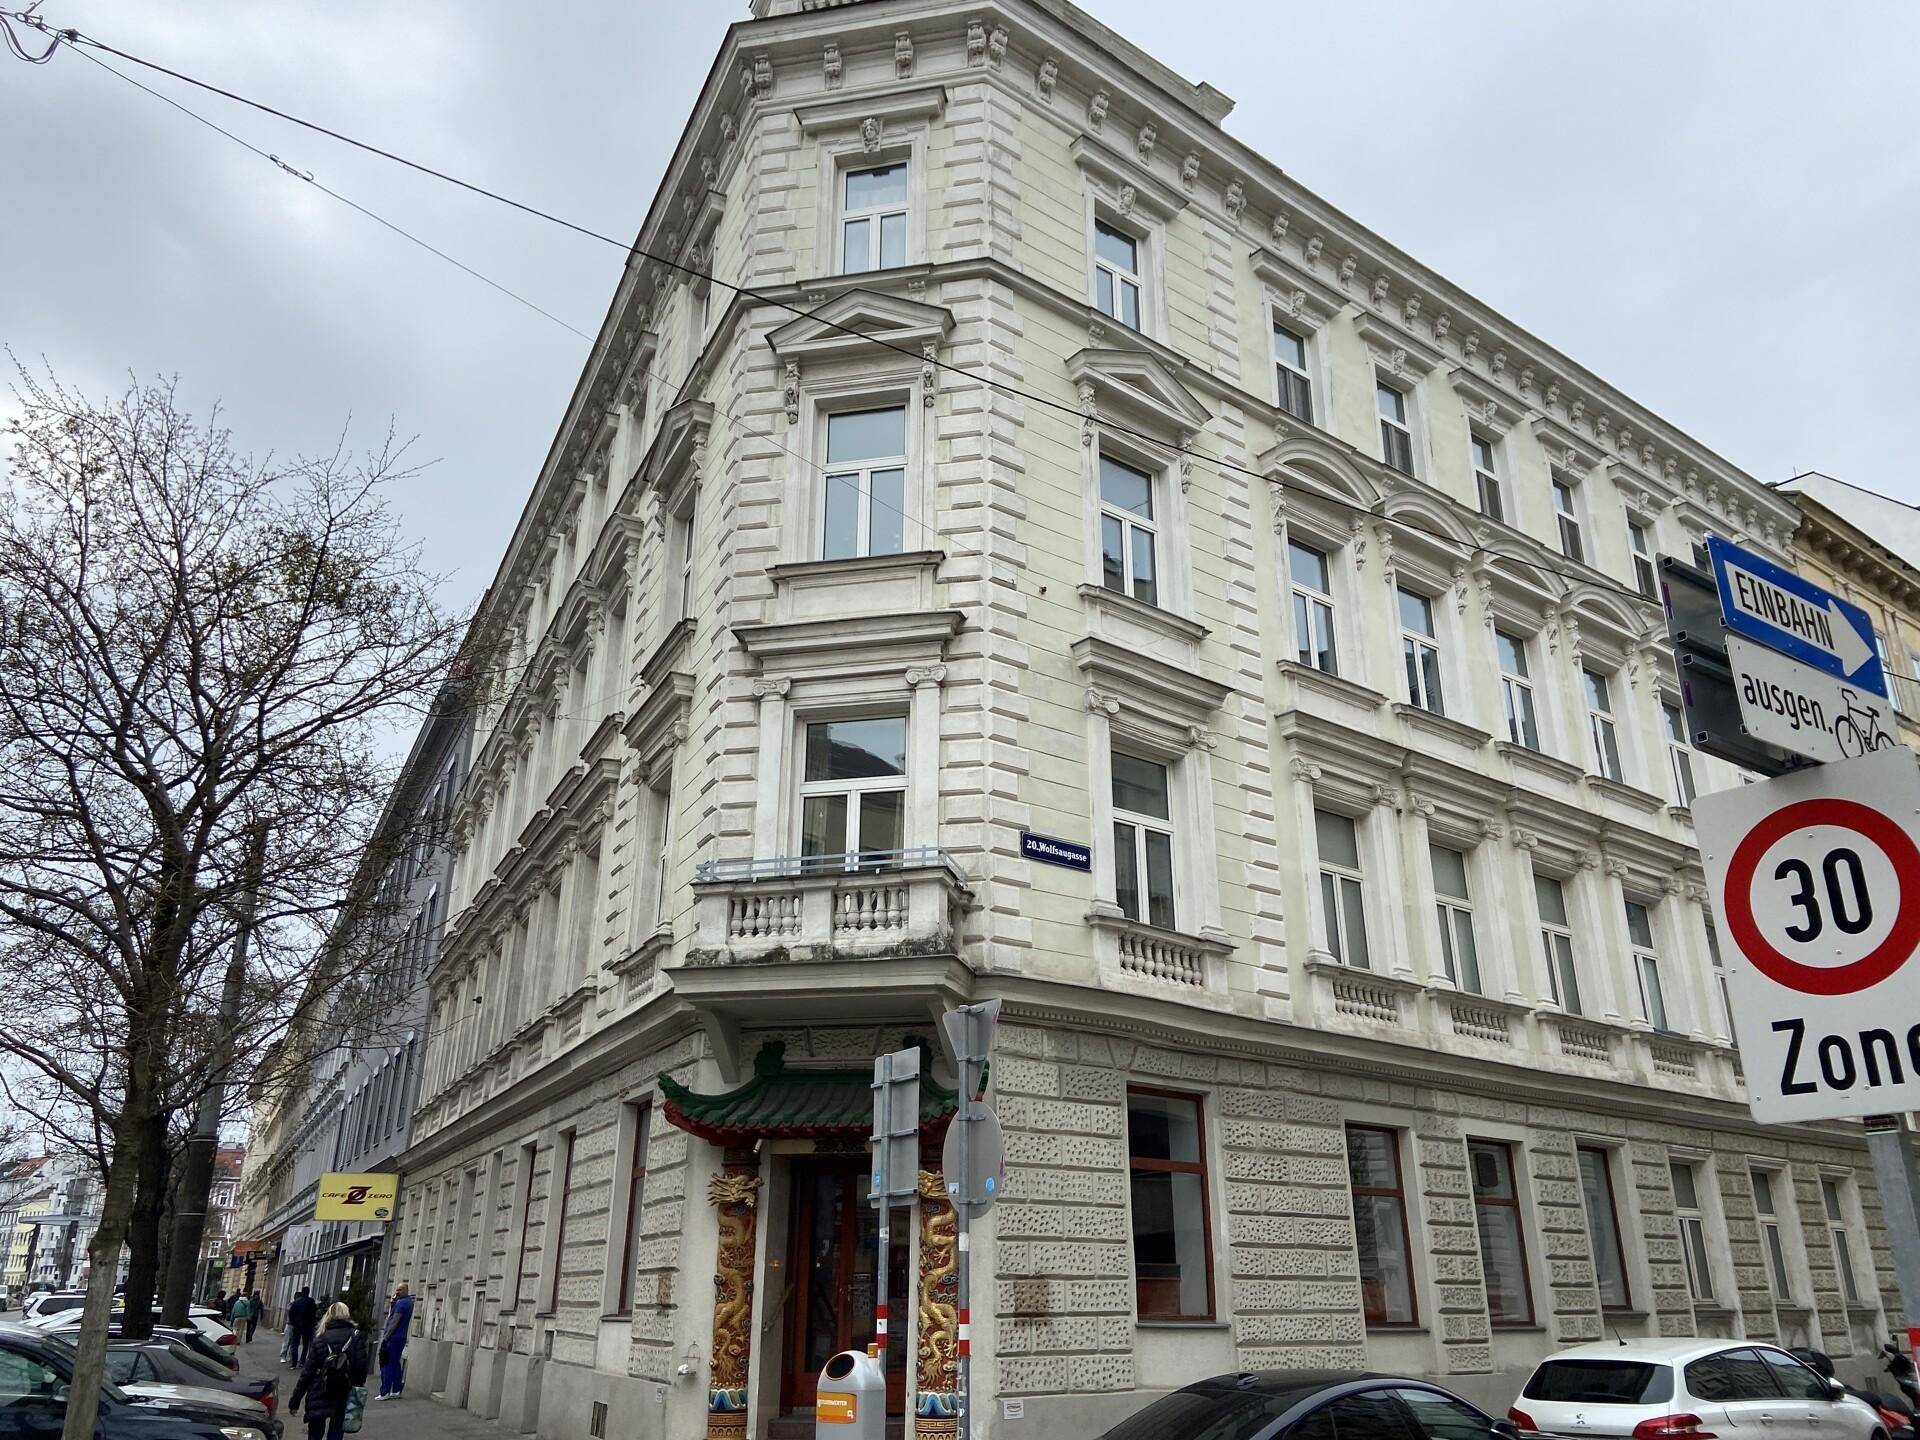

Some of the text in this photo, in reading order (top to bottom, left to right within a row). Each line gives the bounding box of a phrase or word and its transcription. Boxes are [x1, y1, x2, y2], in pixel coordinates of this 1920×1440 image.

[1734, 570, 1835, 650] EINBAHN
[1741, 672, 1834, 735] ausgen.
[1774, 847, 1874, 943] 30
